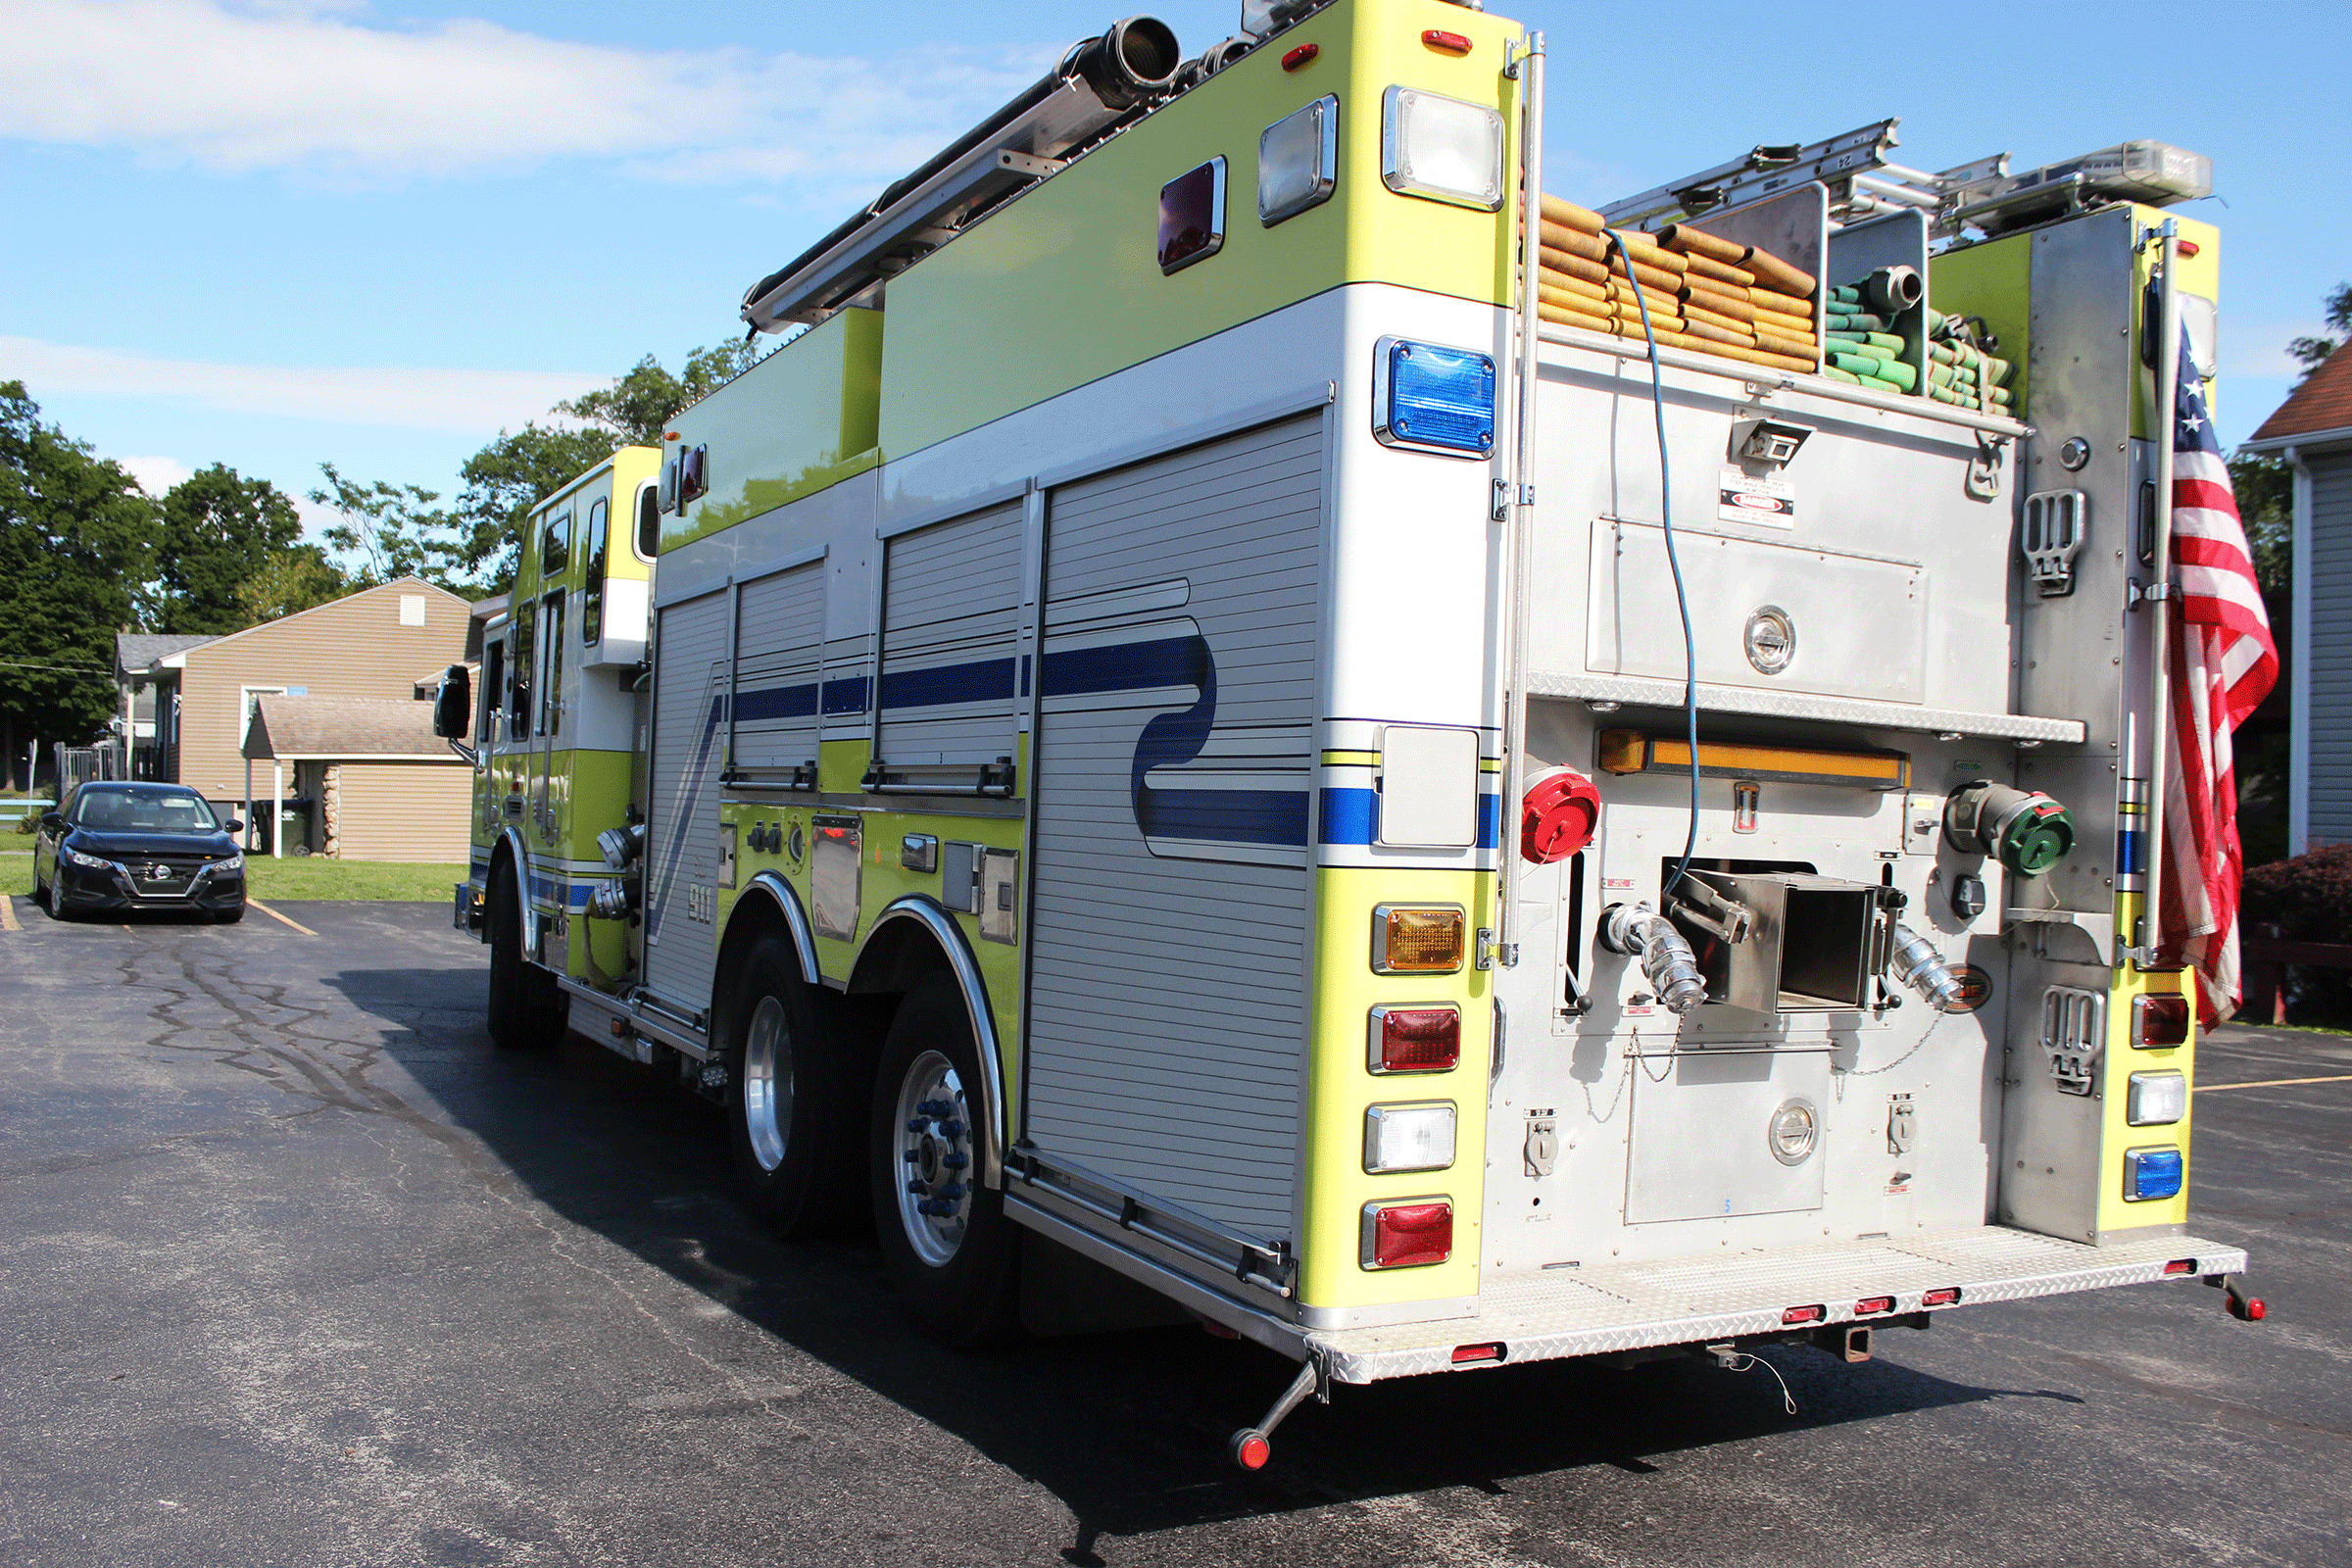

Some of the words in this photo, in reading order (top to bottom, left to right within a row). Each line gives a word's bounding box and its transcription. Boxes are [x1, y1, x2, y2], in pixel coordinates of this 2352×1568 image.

[1838, 155, 1851, 169] 24
[1740, 495, 1775, 510] DANGER
[688, 883, 711, 924] 911
